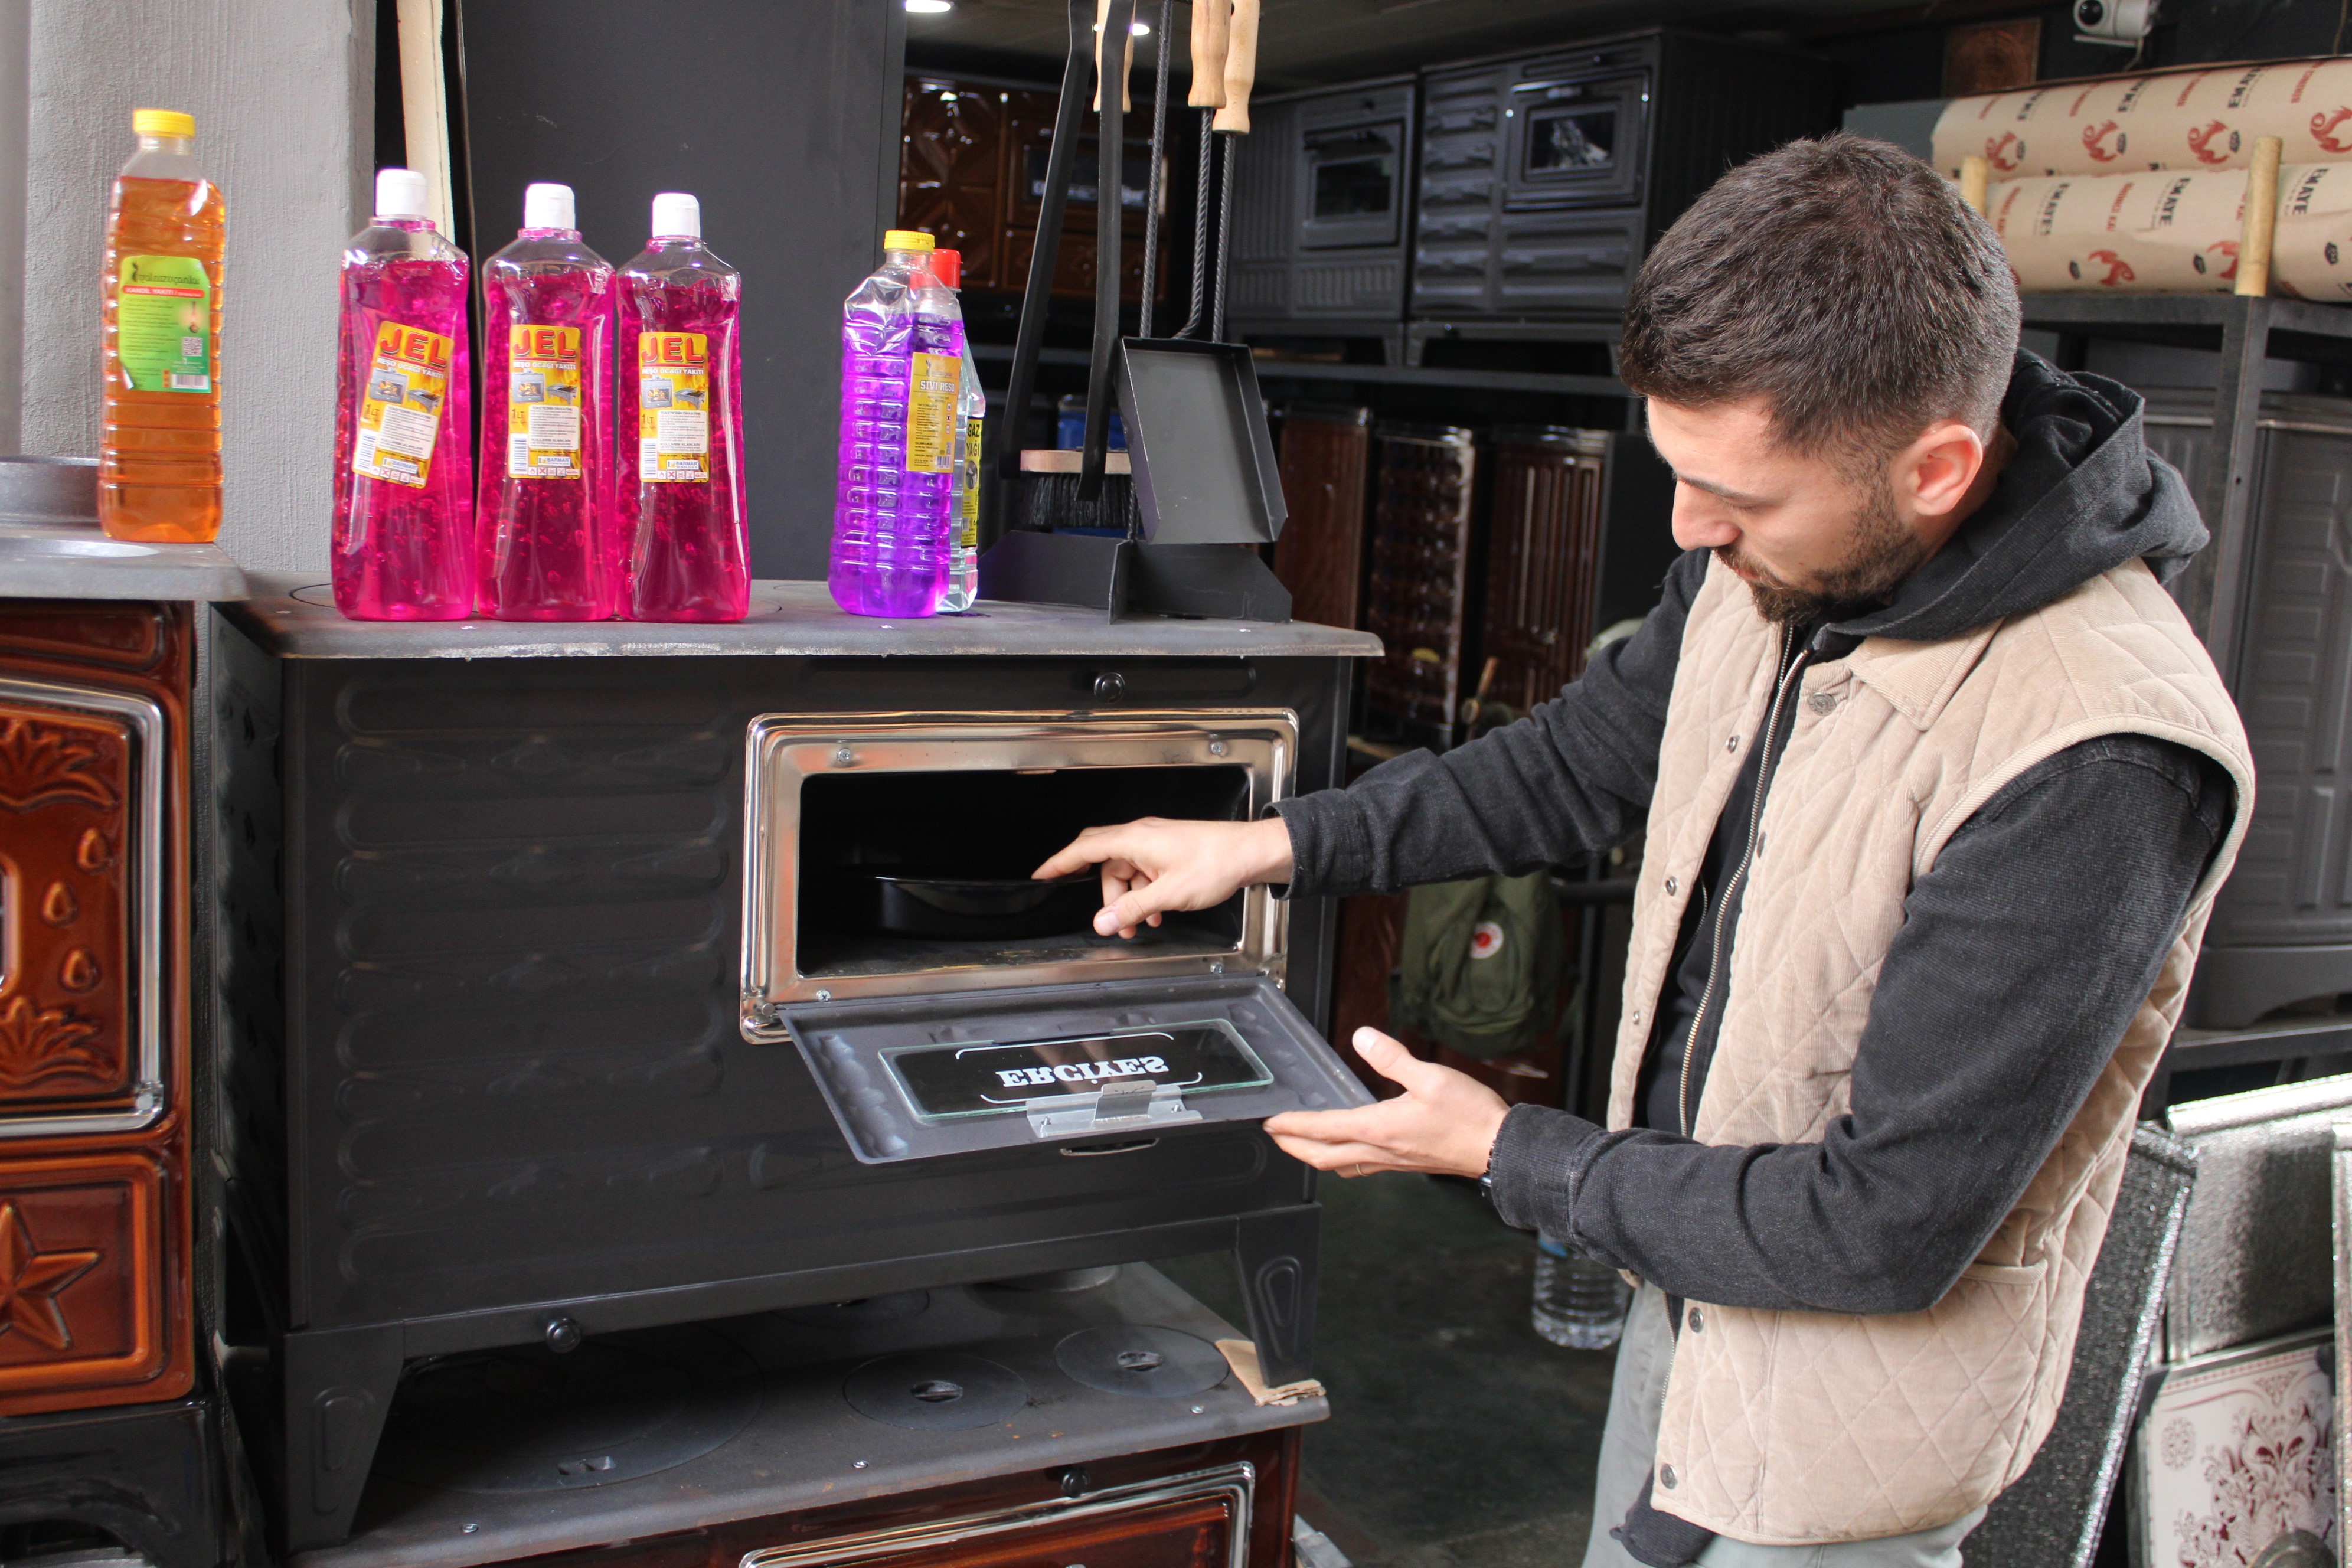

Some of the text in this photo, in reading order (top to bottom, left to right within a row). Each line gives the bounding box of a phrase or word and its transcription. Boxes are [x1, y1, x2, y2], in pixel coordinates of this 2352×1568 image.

[379, 328, 447, 367] JEL
[512, 328, 576, 358] JEL
[641, 336, 704, 363] JEL
[421, 368, 445, 380] YAKITI
[919, 380, 939, 391] SIVI
[511, 408, 516, 419] 1
[642, 414, 646, 424] 1
[968, 423, 980, 437] GAZ
[966, 440, 980, 456] YAĞI
